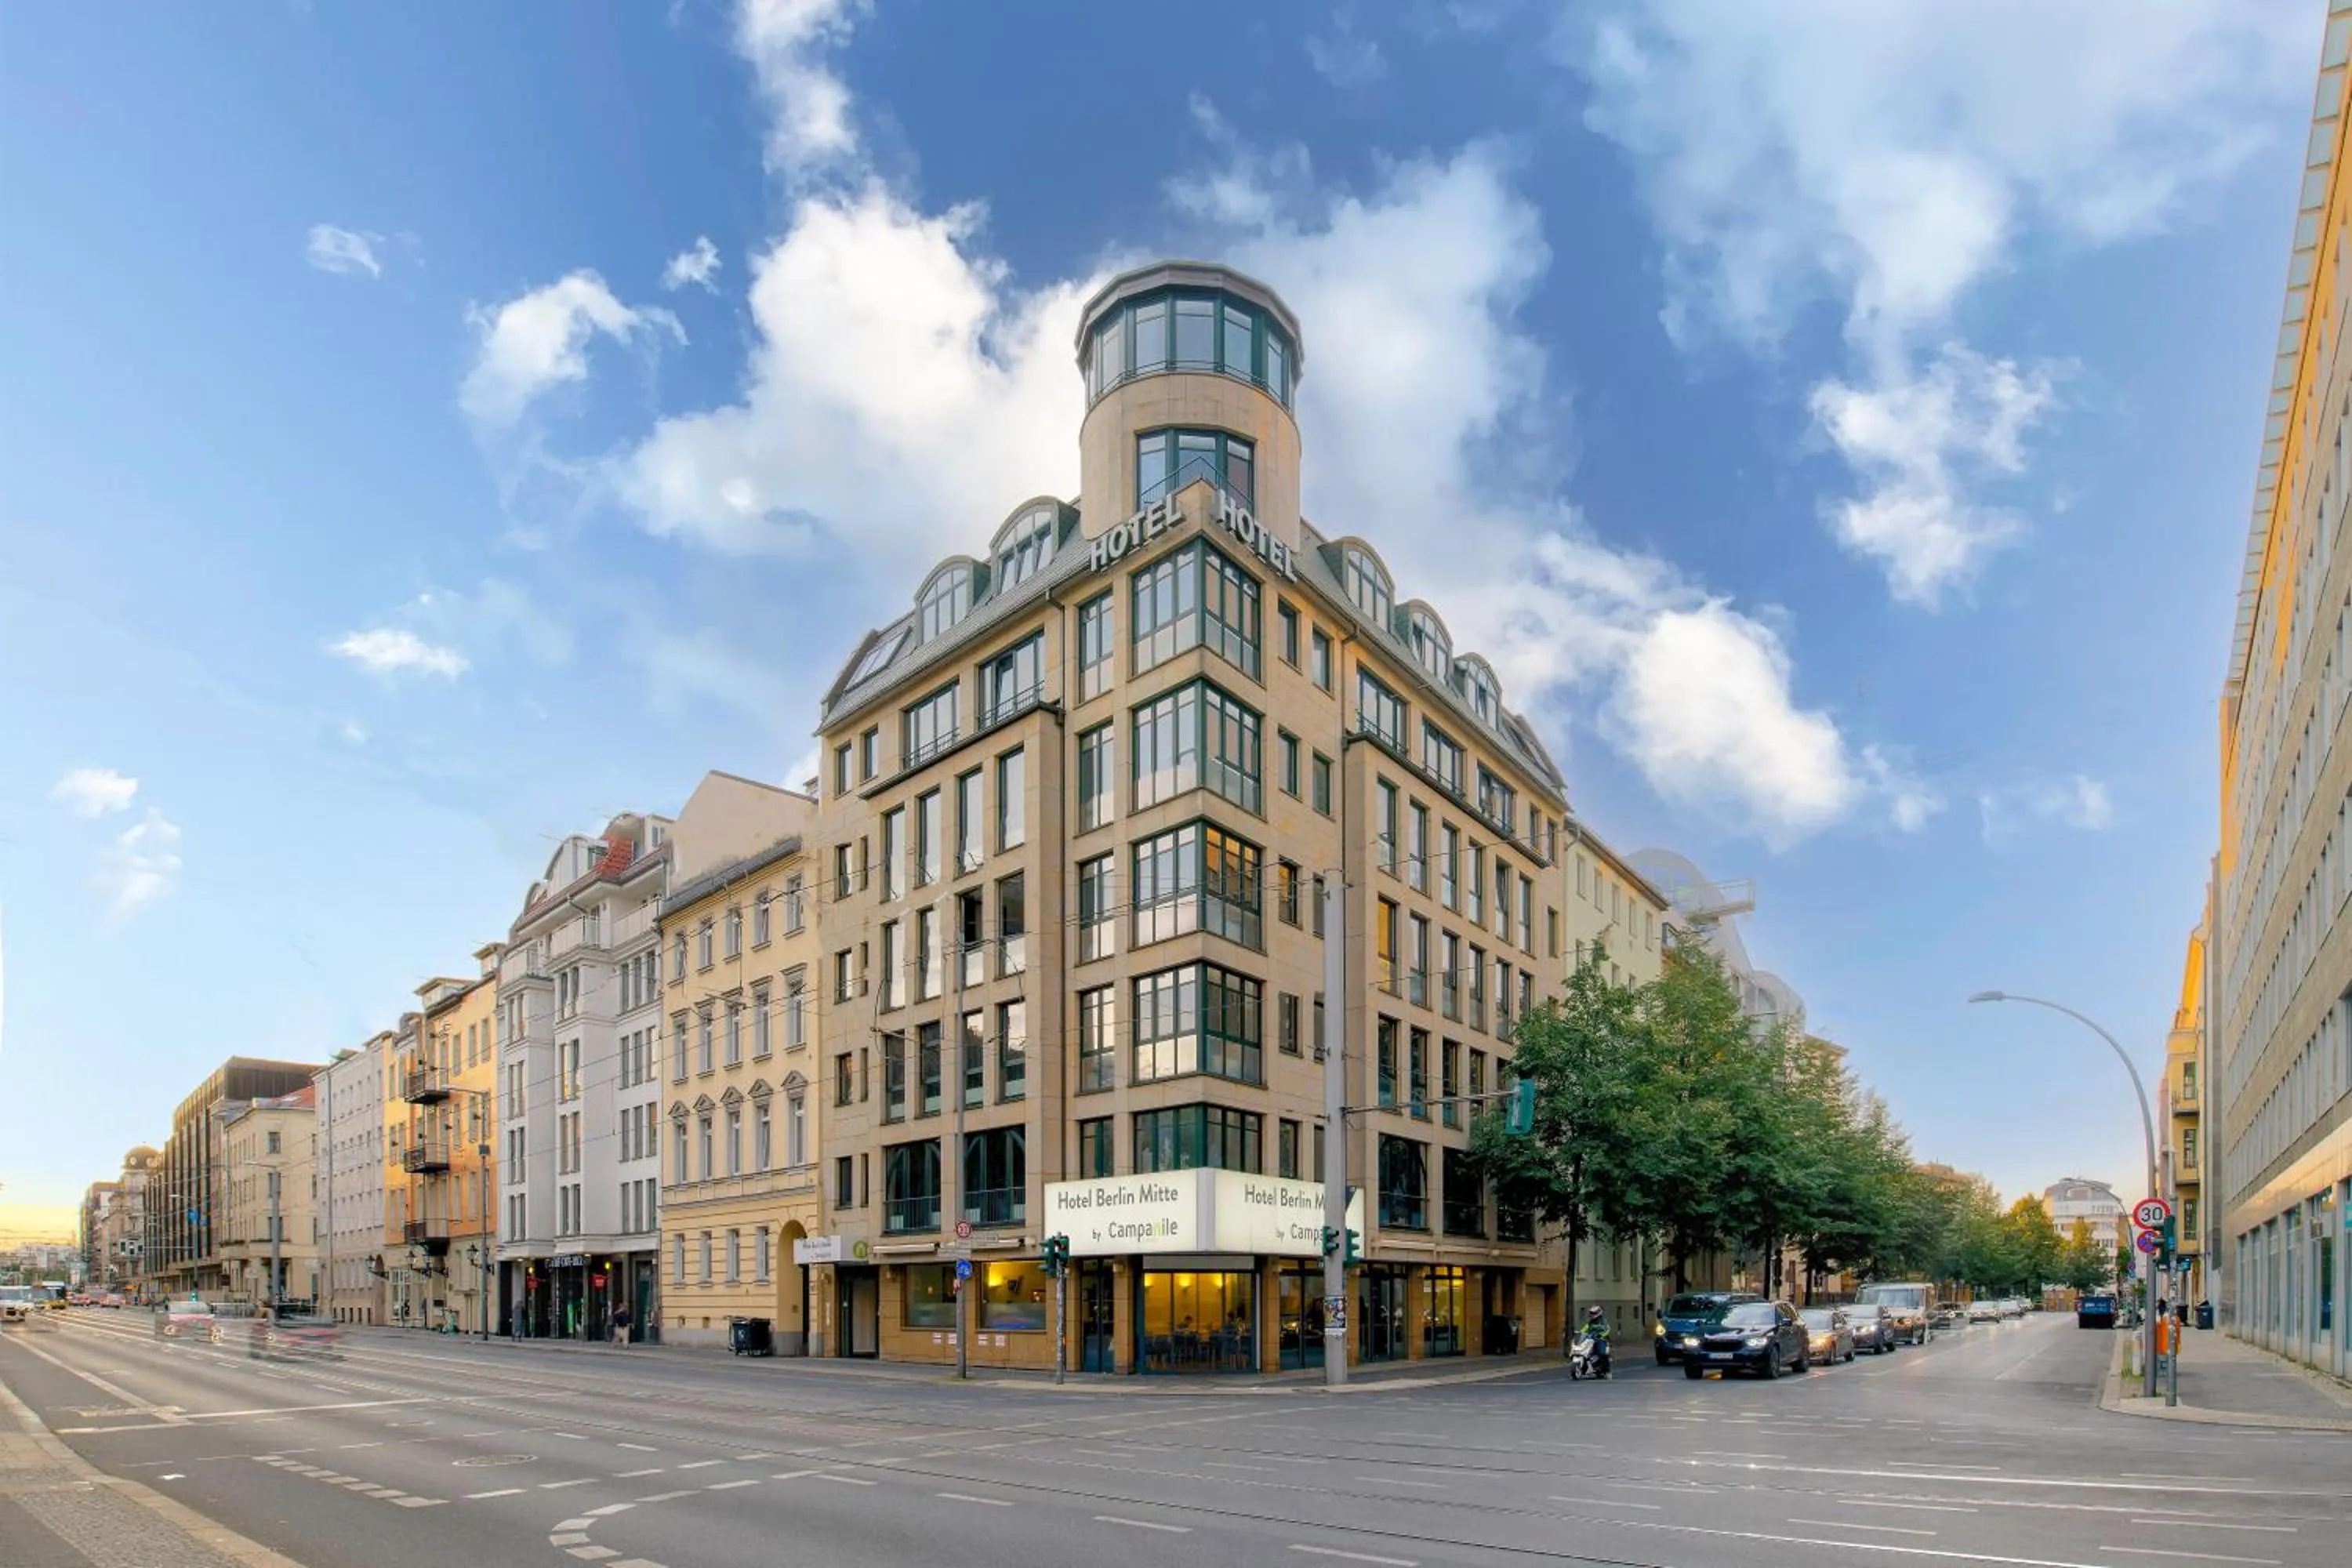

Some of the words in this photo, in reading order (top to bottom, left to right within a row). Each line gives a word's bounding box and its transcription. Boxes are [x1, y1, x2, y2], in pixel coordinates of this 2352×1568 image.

[1090, 493, 1185, 572] HOTEL
[1218, 488, 1298, 583] HOTEL
[1058, 1190, 1091, 1209] Hotel
[1098, 1186, 1134, 1207] Berlin
[1139, 1184, 1178, 1203] Mitte
[1244, 1184, 1276, 1205] Hotel
[1280, 1187, 1312, 1210] Berlin
[2141, 1207, 2163, 1222] 30
[1092, 1229, 1101, 1242] by
[1108, 1218, 1178, 1243] Campanile
